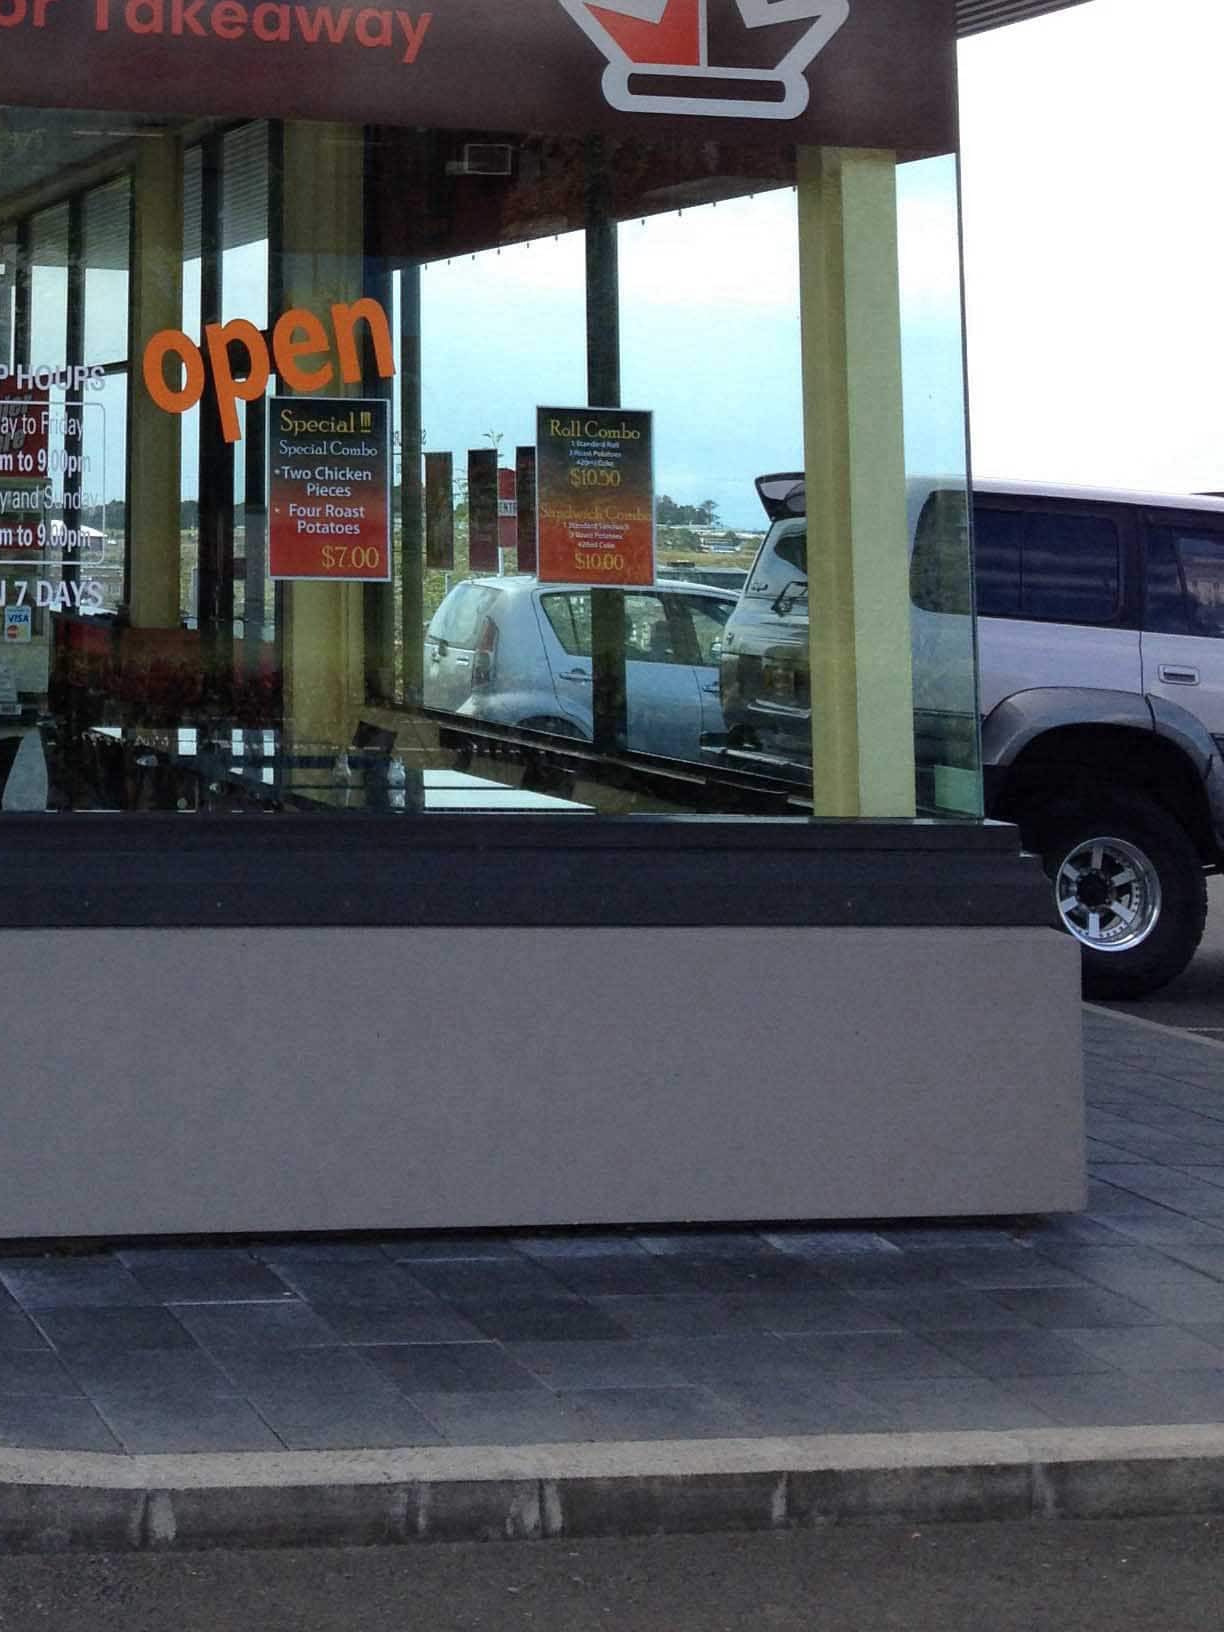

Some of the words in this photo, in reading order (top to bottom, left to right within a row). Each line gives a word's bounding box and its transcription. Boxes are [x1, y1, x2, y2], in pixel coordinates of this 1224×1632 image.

[16, 364, 106, 391] HOURS
[142, 297, 396, 443] open
[21, 413, 36, 435] to
[279, 409, 355, 436] Special
[550, 419, 582, 437] Roll
[584, 420, 641, 440] Combo
[279, 440, 327, 457] Special
[329, 441, 378, 457] Combo
[17, 451, 33, 472] to
[281, 466, 312, 480] Two
[314, 467, 372, 481] Chicken
[12, 487, 39, 510] and
[306, 483, 352, 497] Pieces
[288, 504, 322, 518] Four
[325, 504, 365, 518] Roast
[17, 526, 34, 547] to
[38, 524, 91, 552] 9.00pm
[297, 520, 360, 535] Potatoes
[322, 544, 380, 569] $7.00
[15, 581, 30, 607] 7
[36, 581, 105, 608] DAYS
[7, 614, 29, 623] VISA
